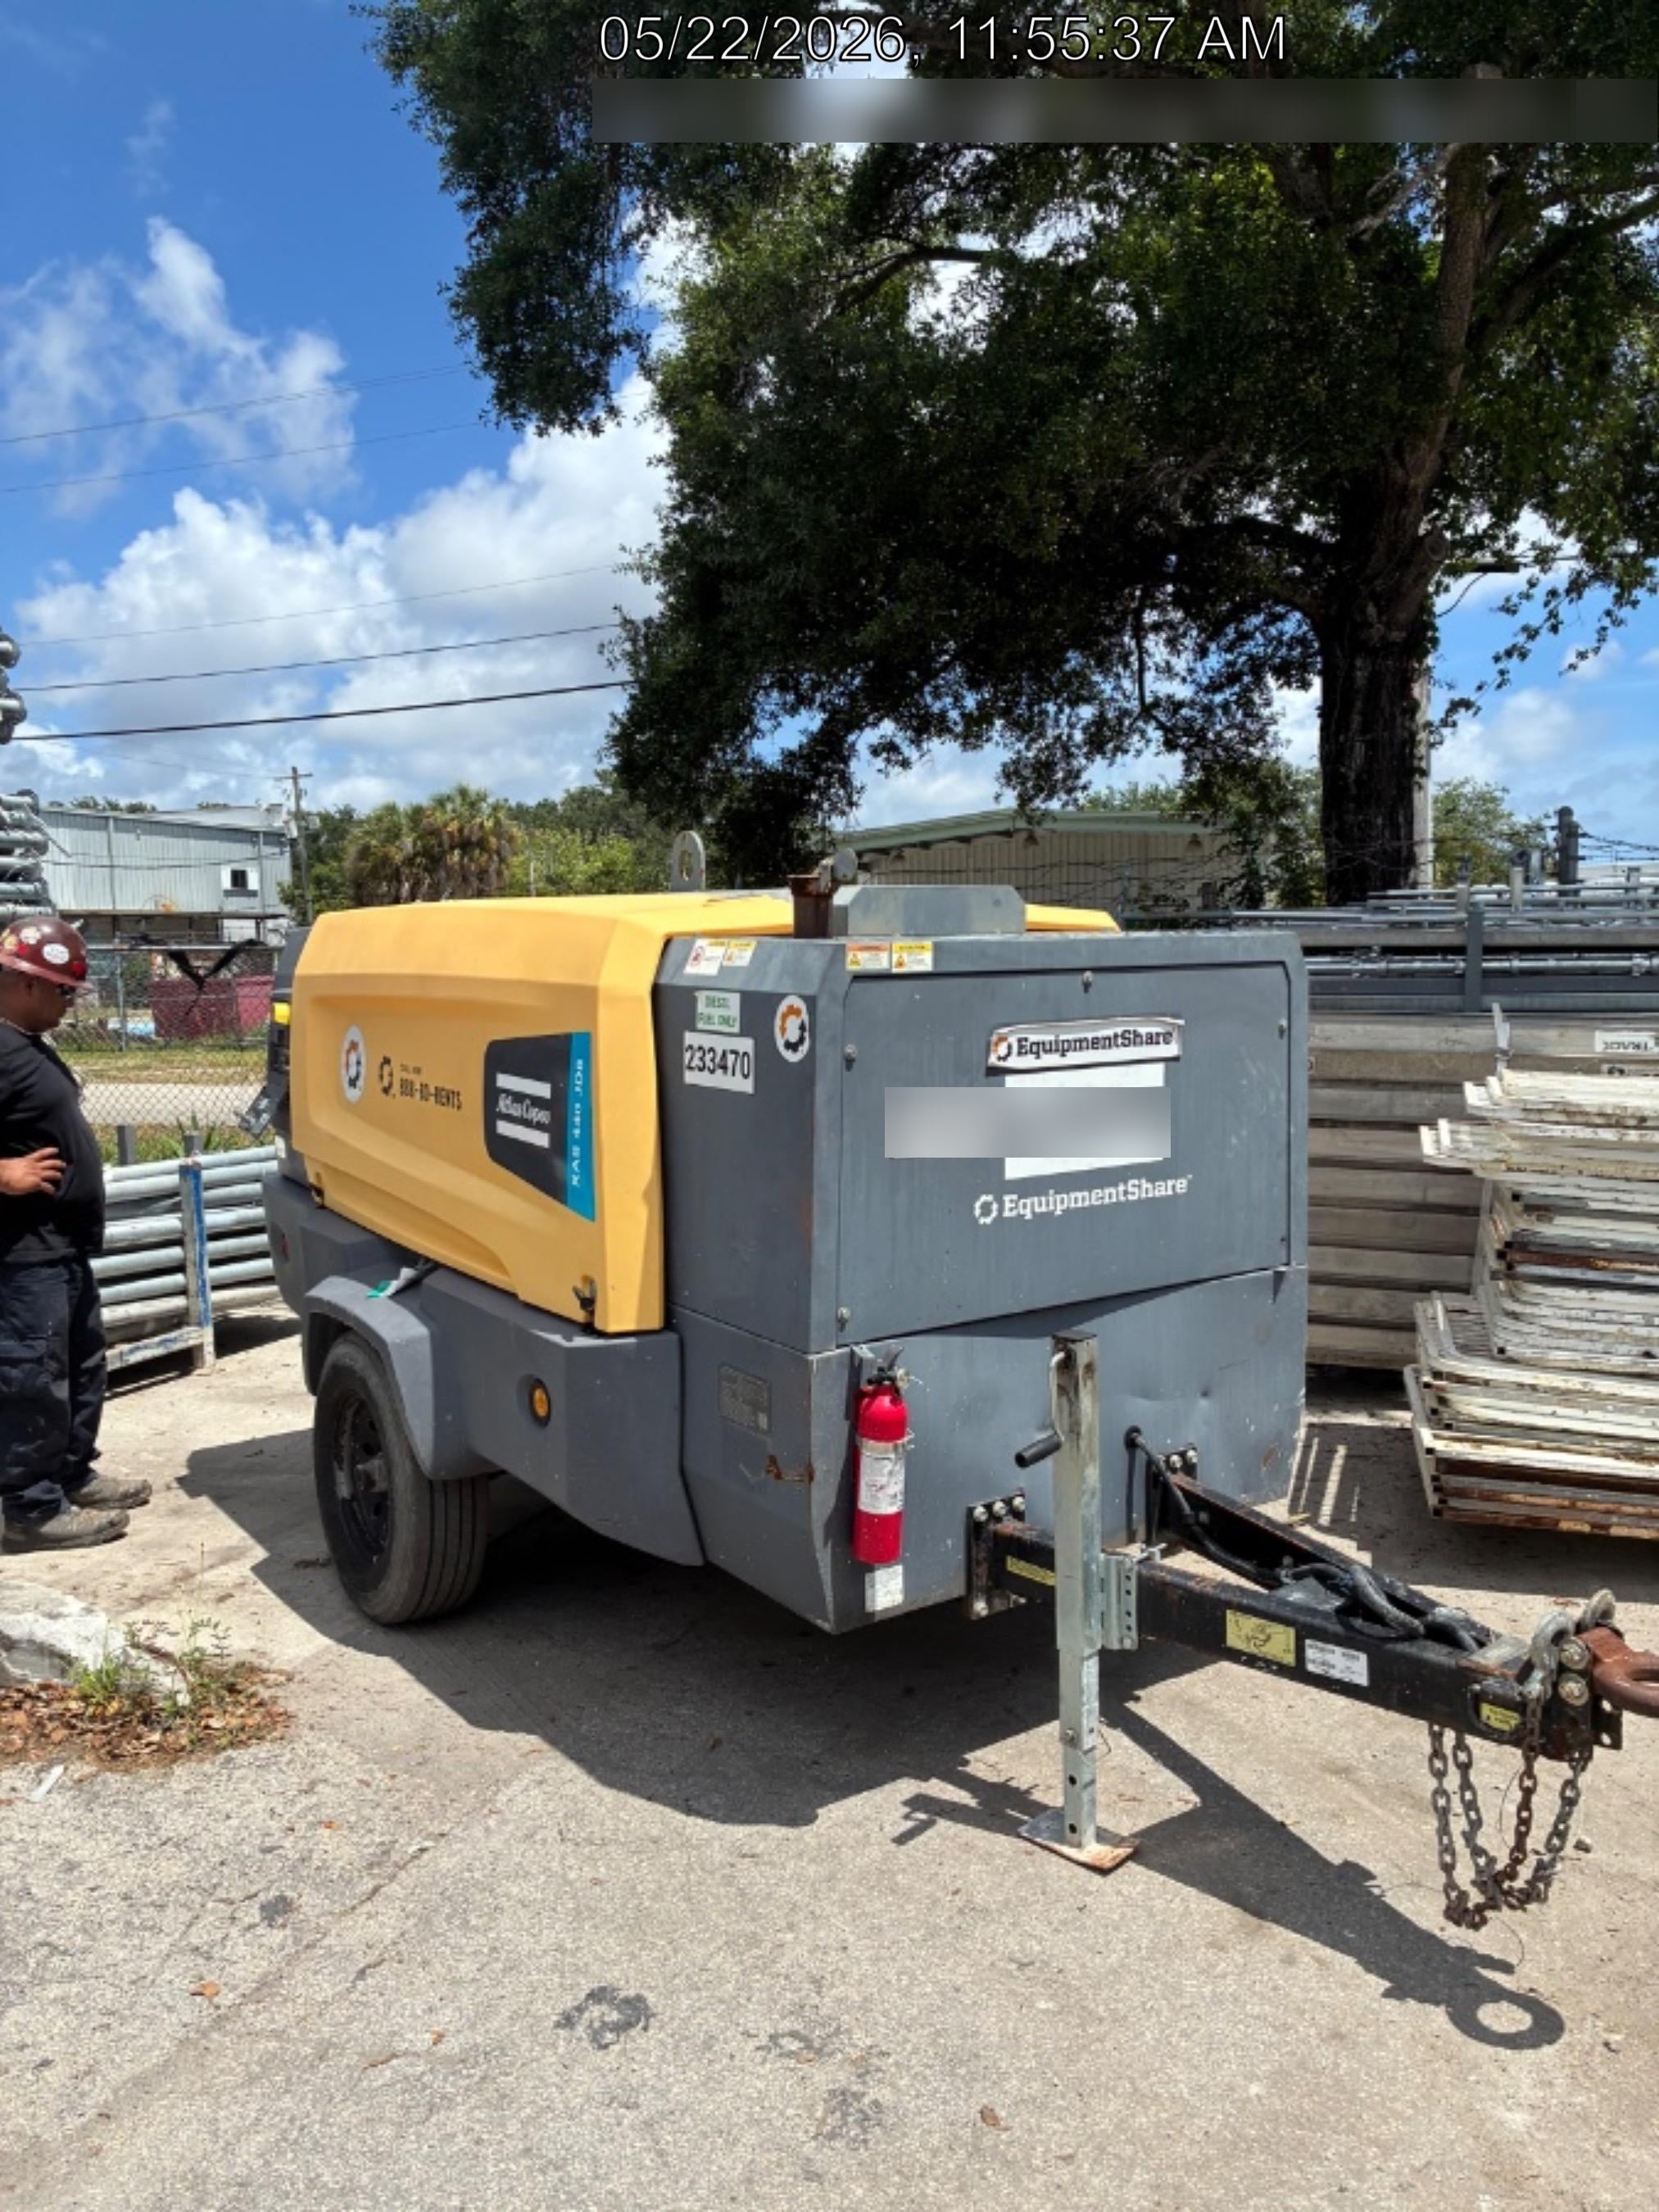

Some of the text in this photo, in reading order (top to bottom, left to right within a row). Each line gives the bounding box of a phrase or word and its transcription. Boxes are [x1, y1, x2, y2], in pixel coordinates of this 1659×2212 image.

[1016, 1028, 1174, 1058] EquipmentShare
[685, 1045, 750, 1079] 233470
[496, 1093, 551, 1125] Atlas Copco
[1002, 1176, 1189, 1221] EquipmentShare
